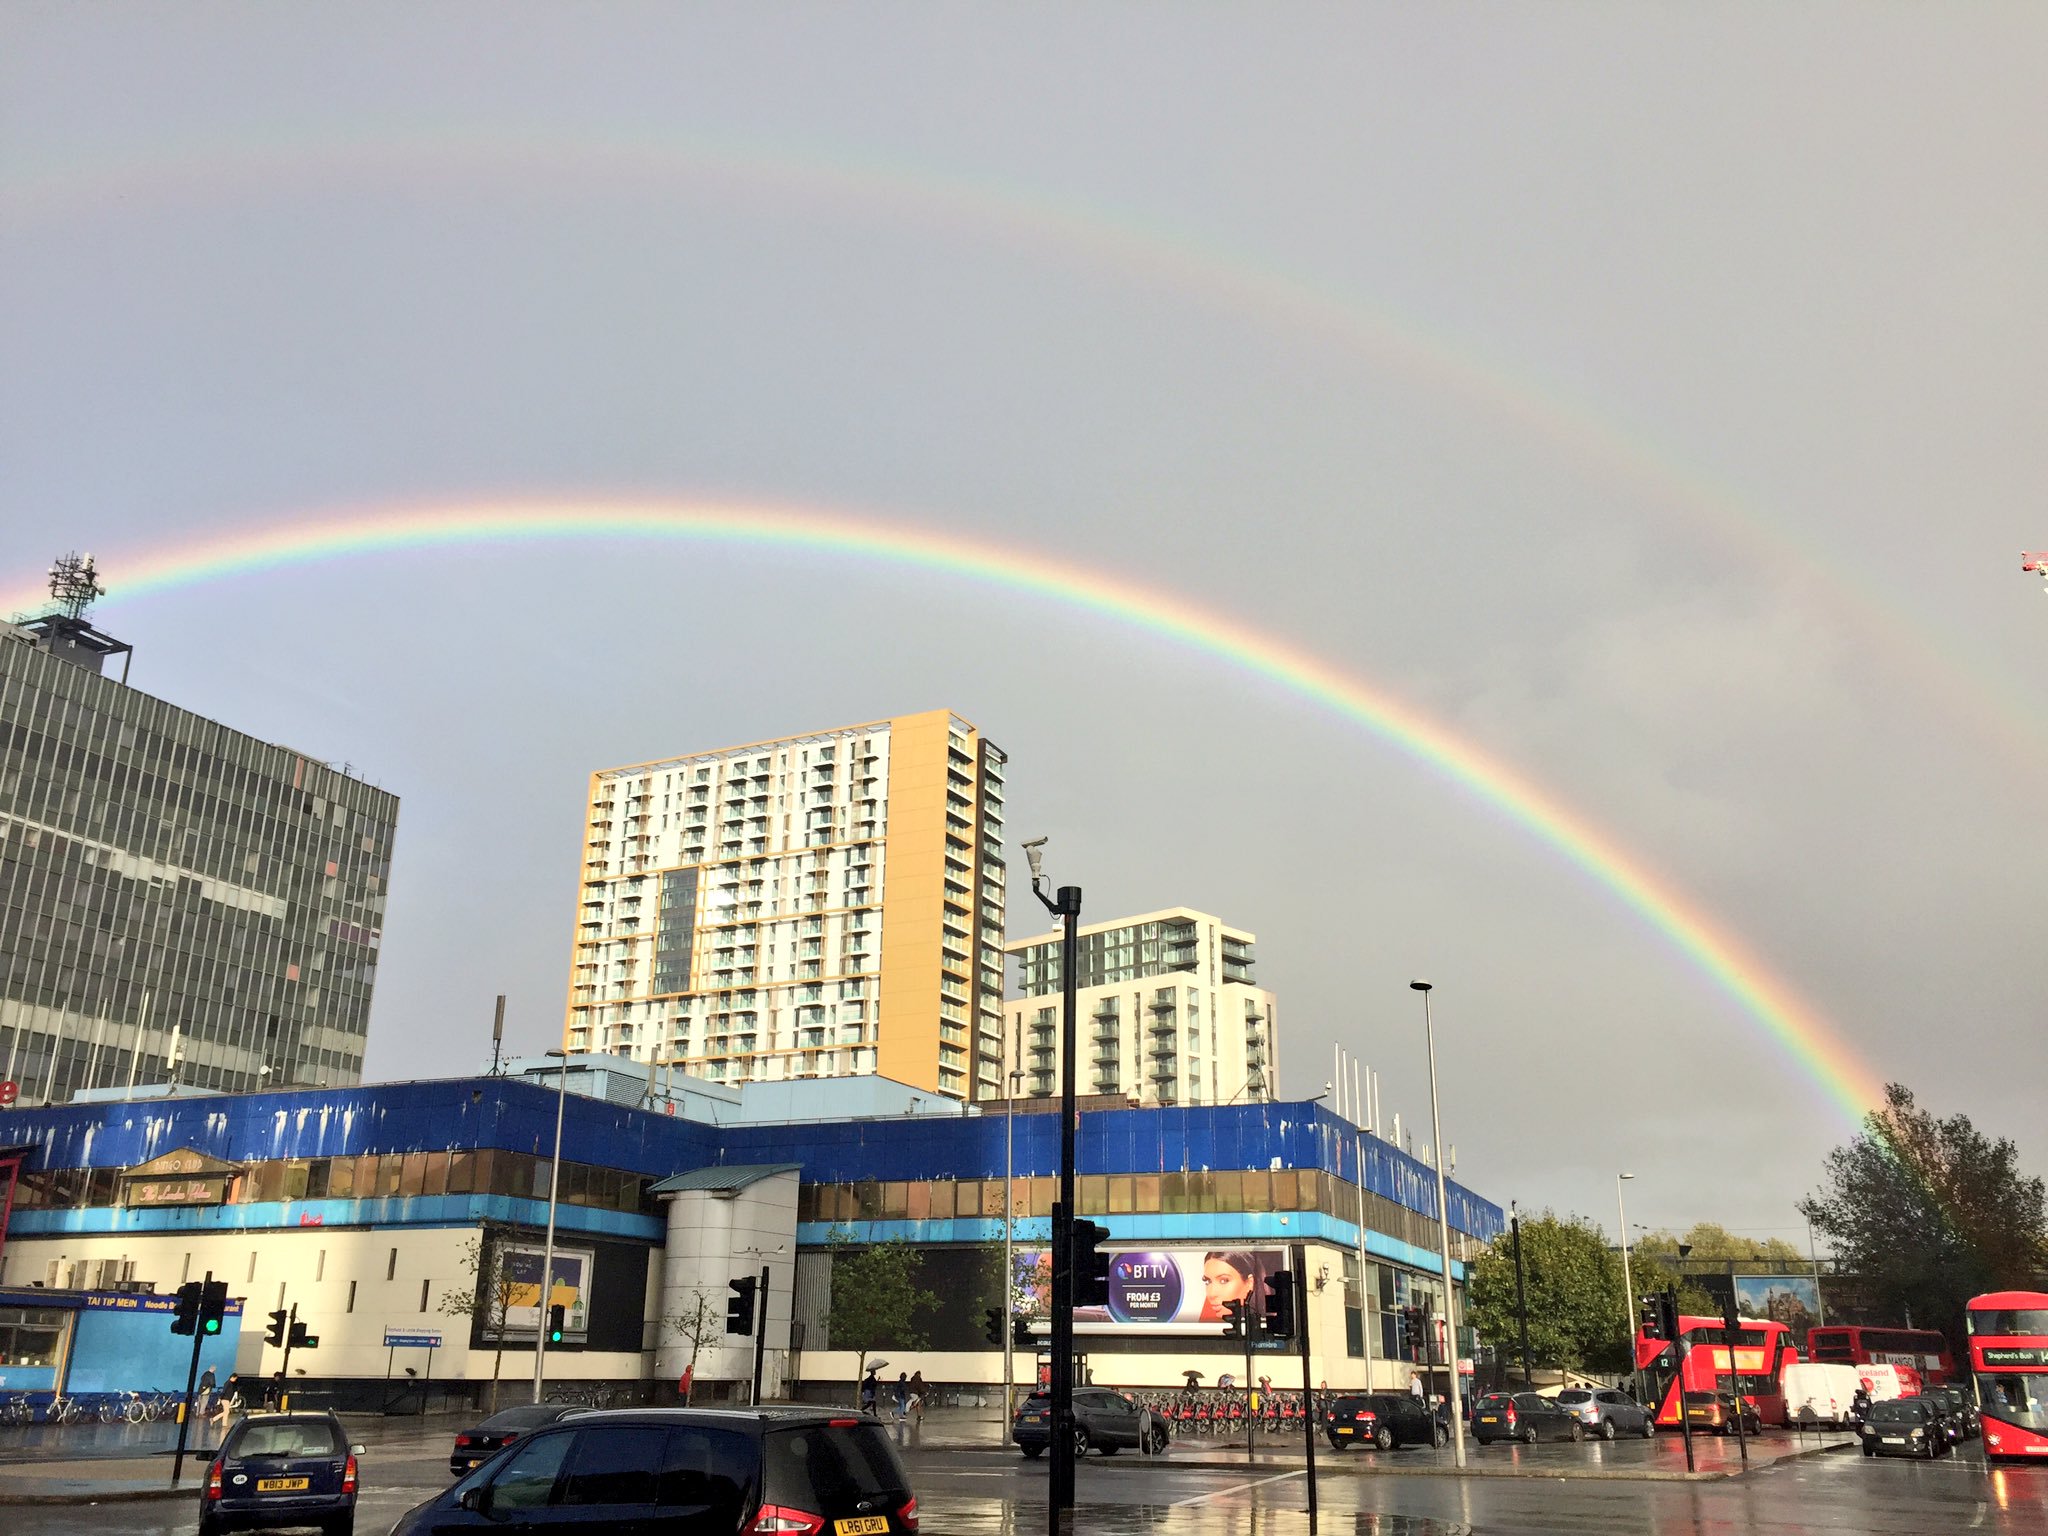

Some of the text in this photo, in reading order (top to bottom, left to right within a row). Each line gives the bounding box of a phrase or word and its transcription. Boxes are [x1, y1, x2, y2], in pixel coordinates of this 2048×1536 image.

[1133, 1264, 1168, 1279] BT TV
[1126, 1292, 1161, 1302] FROM £3
[87, 1296, 100, 1305] TAI
[102, 1297, 115, 1306] TIP
[117, 1298, 137, 1308] MEIN
[145, 1300, 169, 1309] Noodle
[1987, 1351, 2018, 1360] Shepherd's
[2019, 1351, 2034, 1359] Bush
[1660, 1358, 1669, 1367] 12
[1859, 1369, 1889, 1377] Iceland
[263, 1479, 284, 1490] WB13
[840, 1520, 864, 1535] LR61
